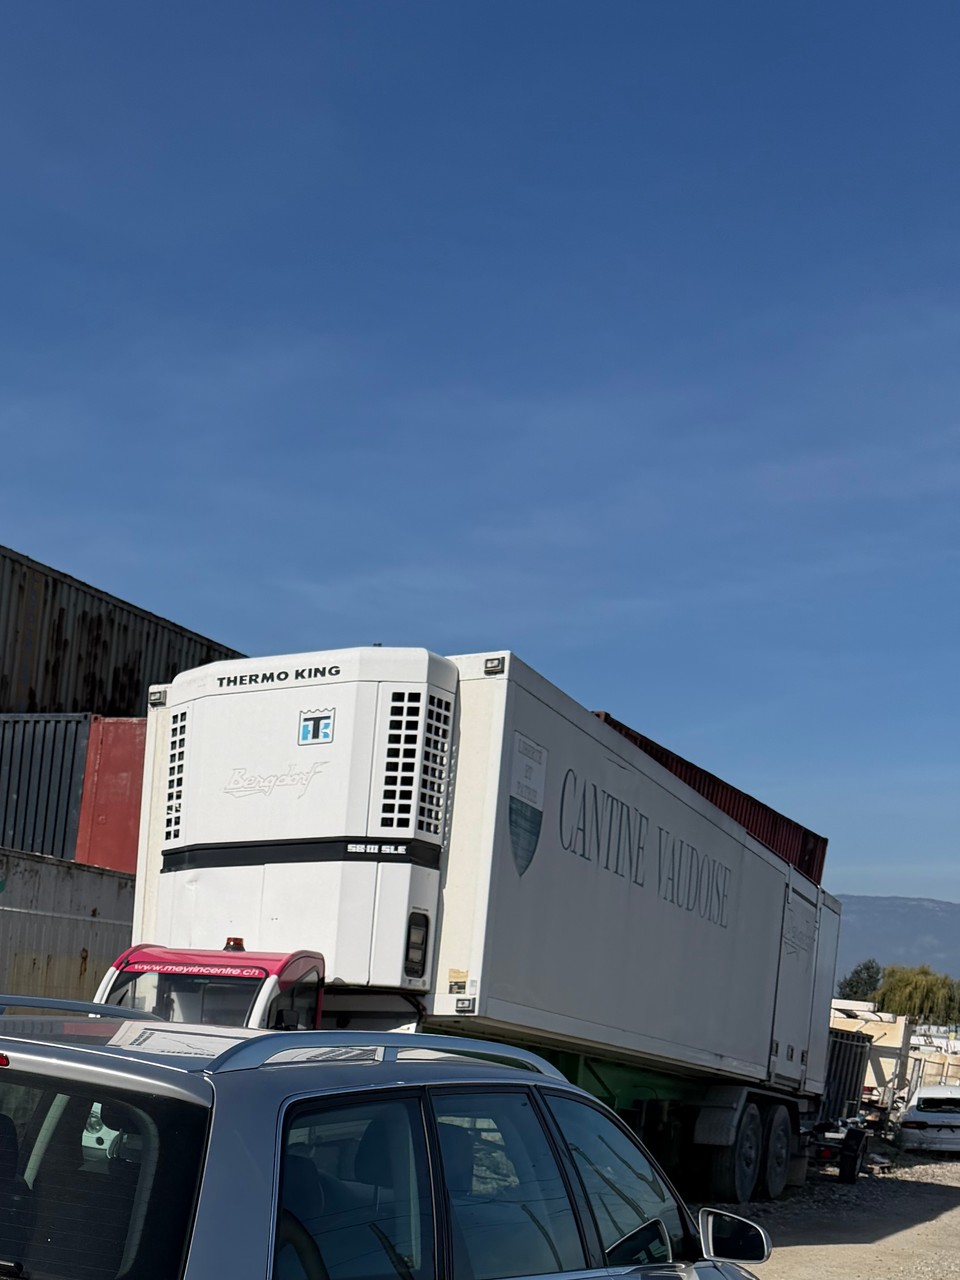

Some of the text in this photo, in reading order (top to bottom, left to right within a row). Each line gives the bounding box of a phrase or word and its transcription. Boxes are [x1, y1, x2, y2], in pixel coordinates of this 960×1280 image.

[217, 665, 341, 688] THERMO KING
[381, 845, 407, 854] SLE
[559, 768, 732, 929] CANTINE VAUDOISE
[134, 964, 259, 976] www.meyrincentre.ch
